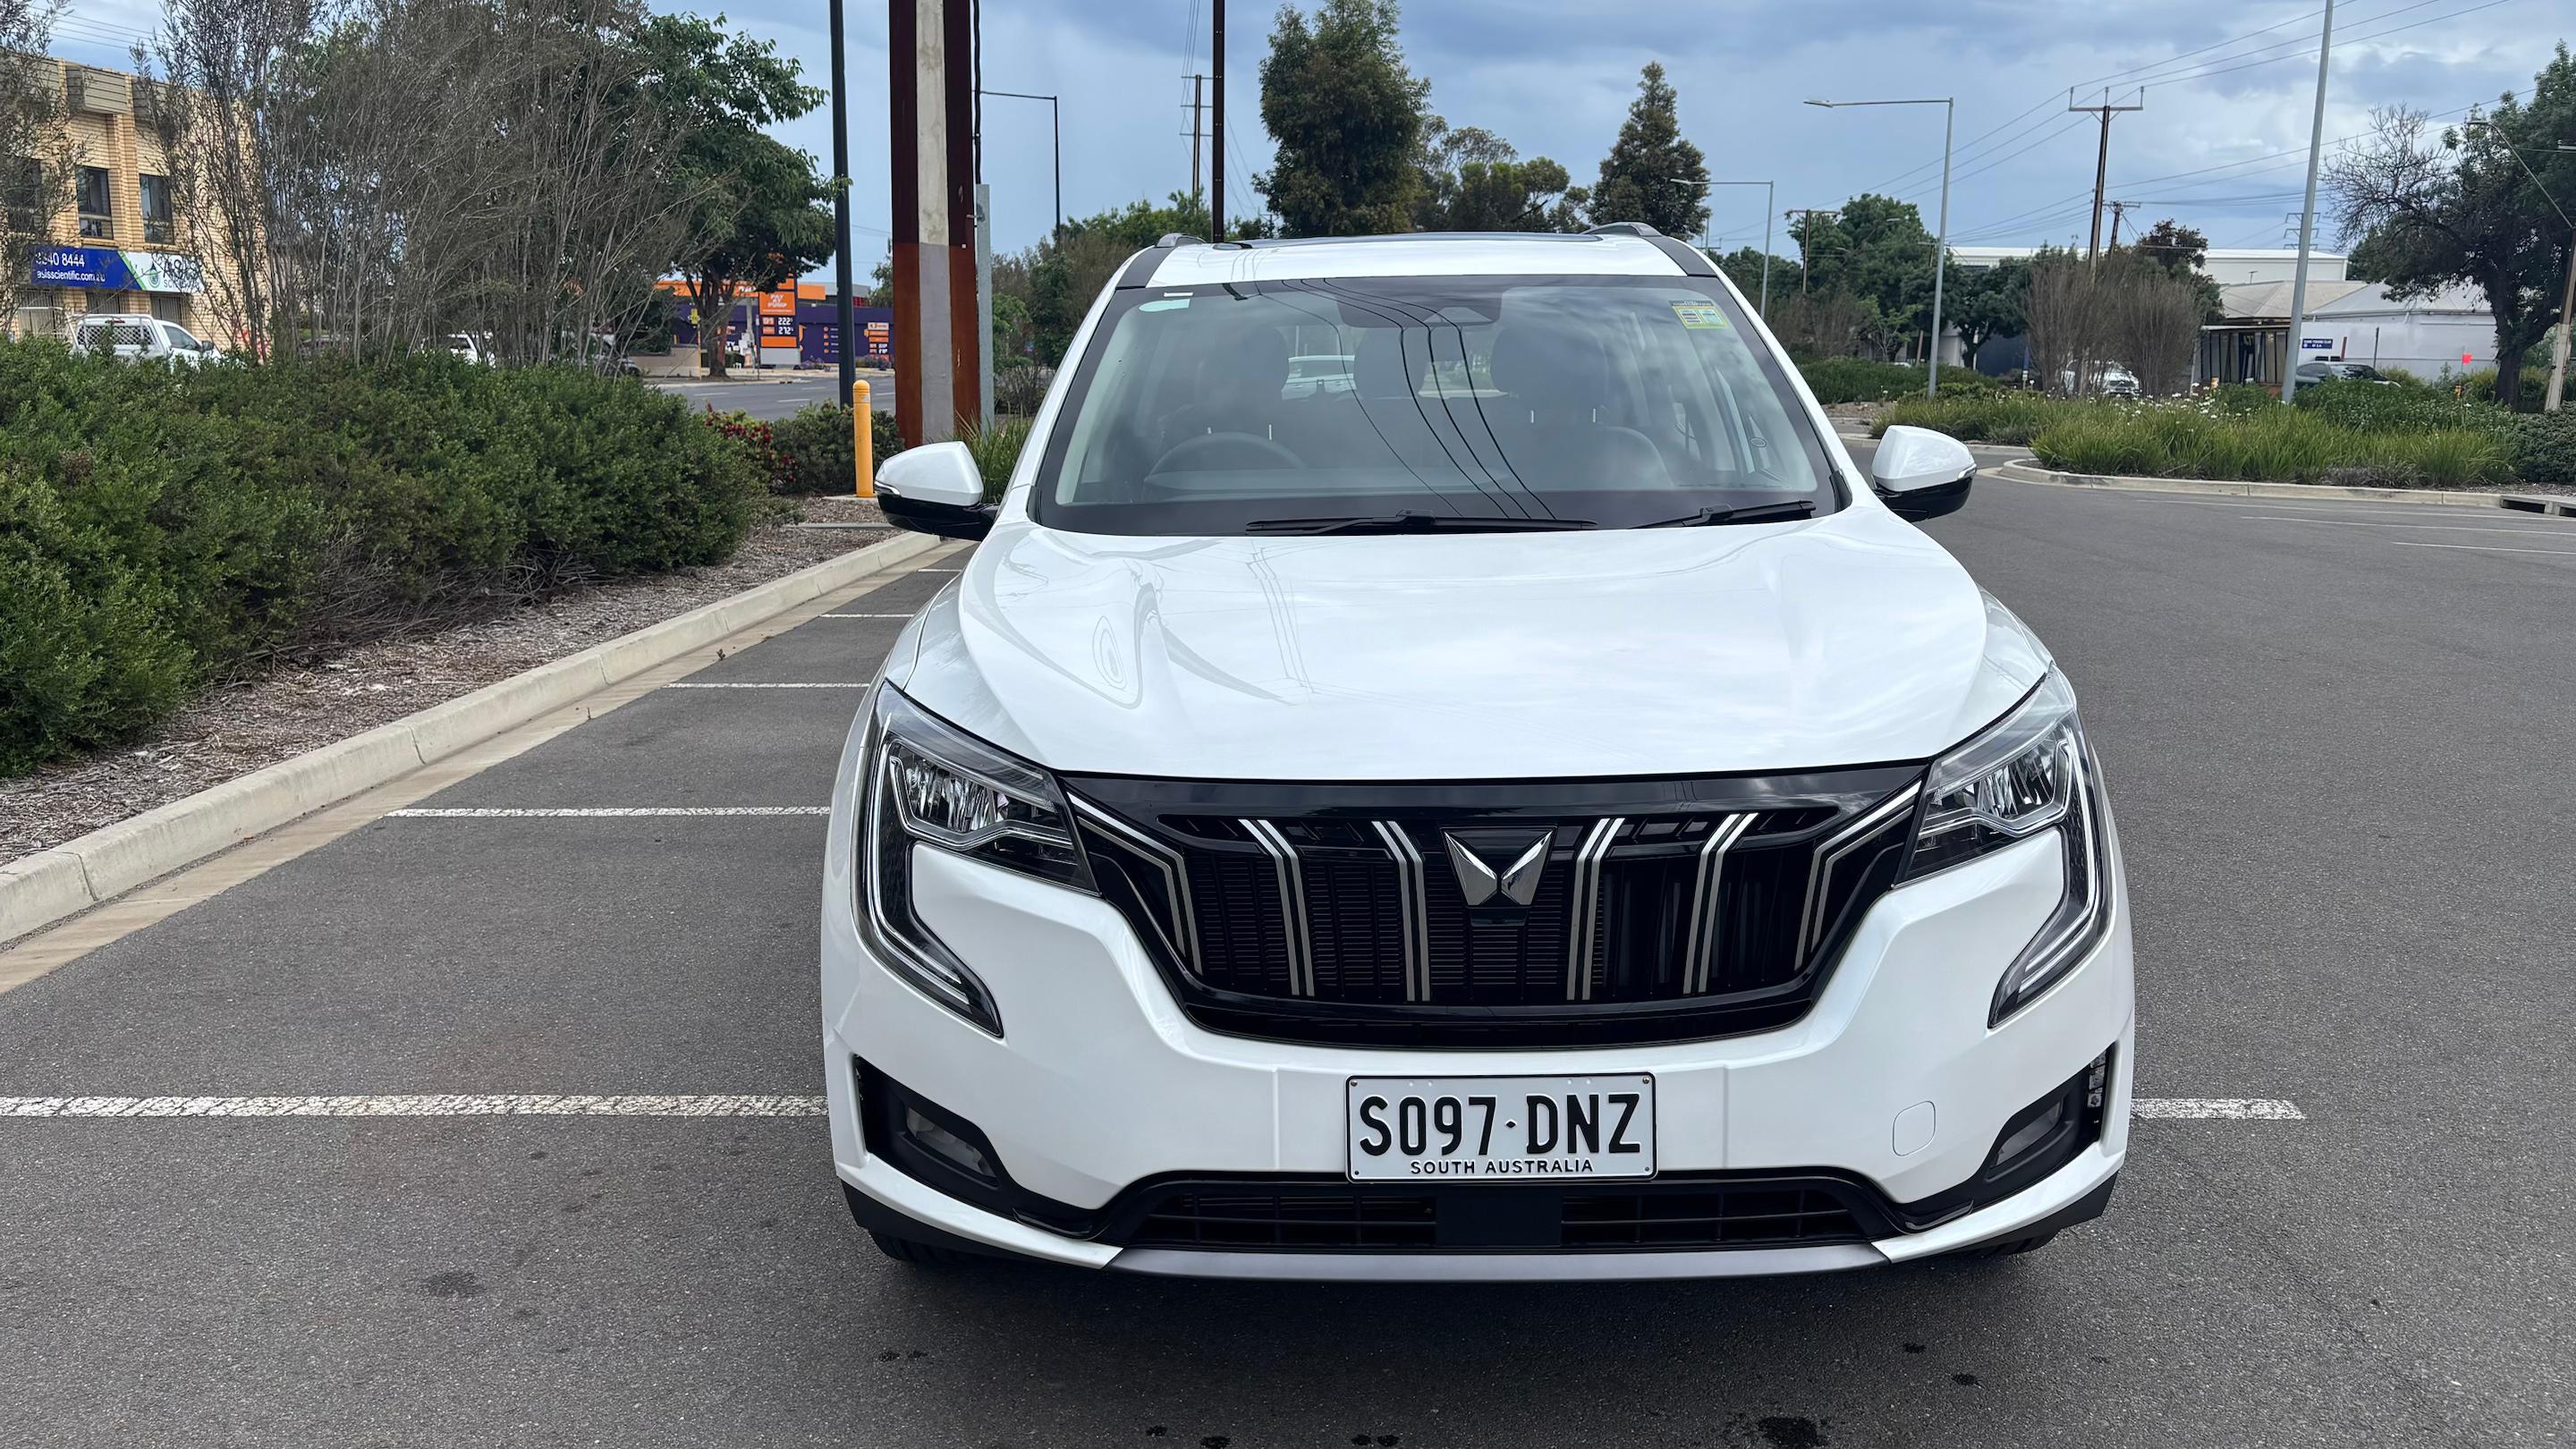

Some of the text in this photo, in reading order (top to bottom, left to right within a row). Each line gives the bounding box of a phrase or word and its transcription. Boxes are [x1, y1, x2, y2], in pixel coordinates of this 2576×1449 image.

[62, 252, 85, 267] 8444
[1411, 1158, 1594, 1174] SOUTH AUSTRALIA
